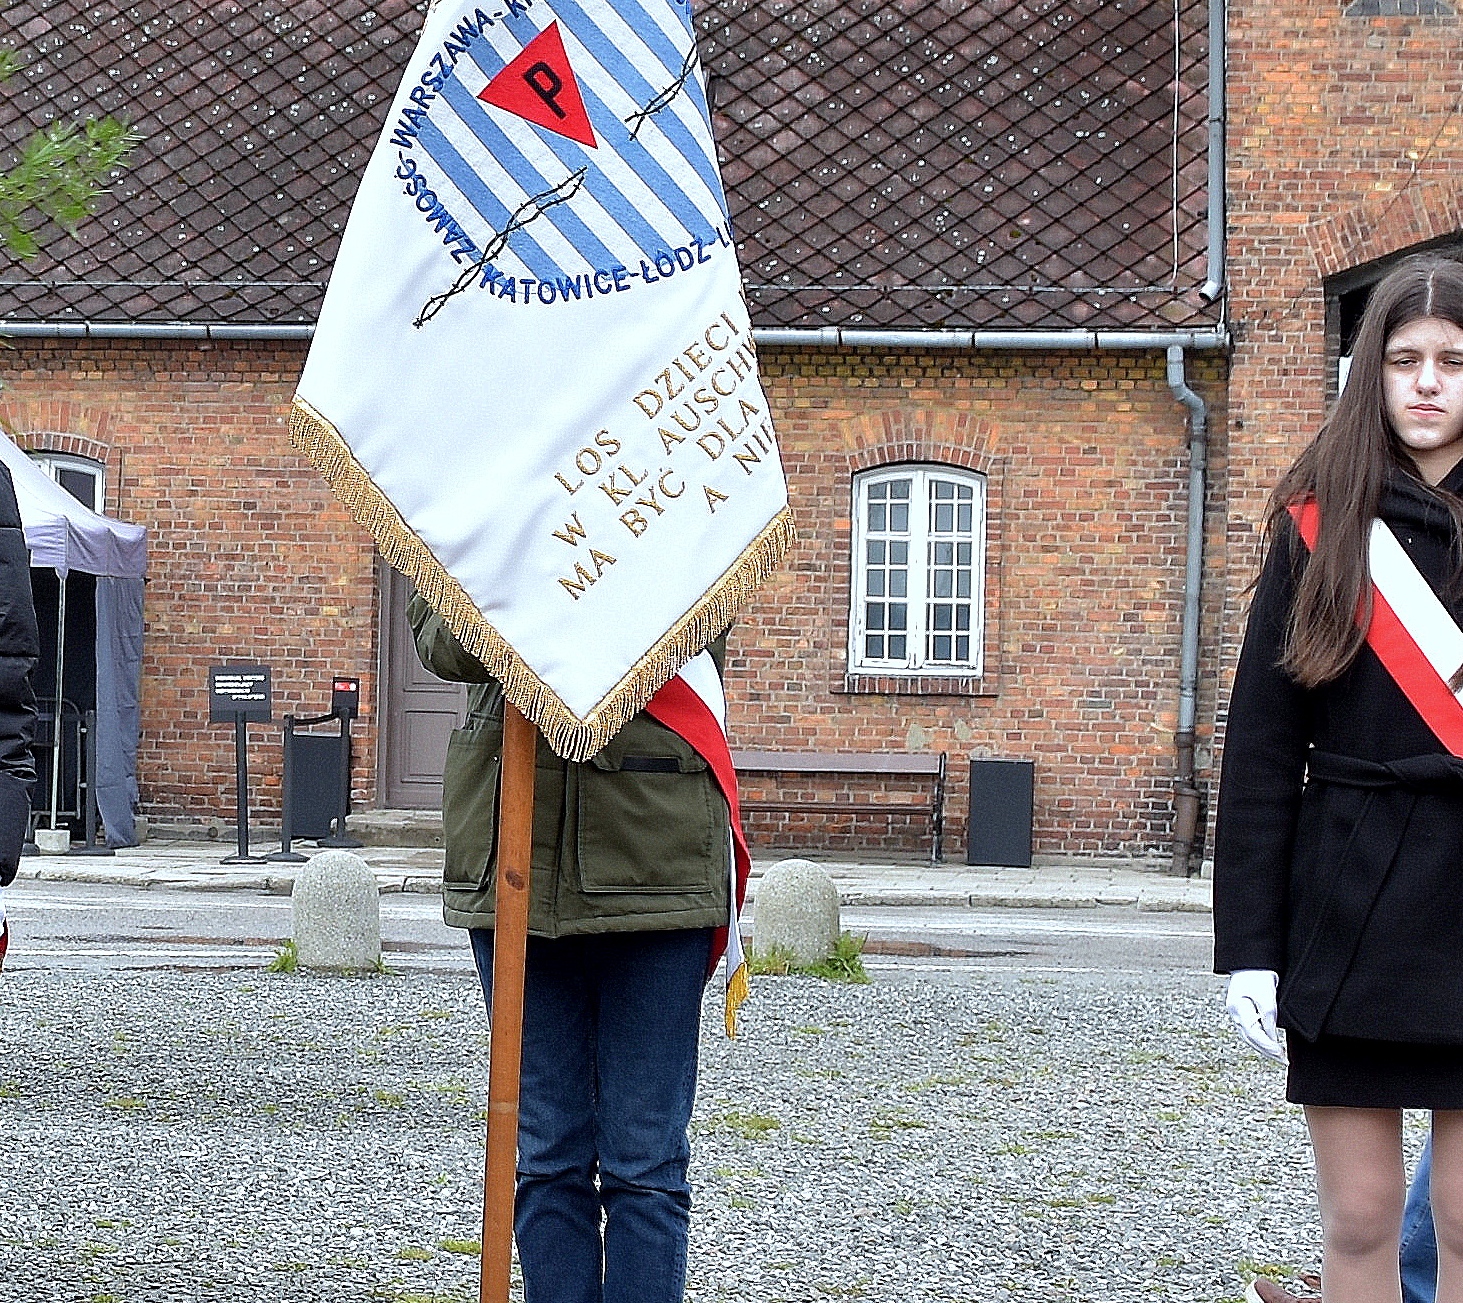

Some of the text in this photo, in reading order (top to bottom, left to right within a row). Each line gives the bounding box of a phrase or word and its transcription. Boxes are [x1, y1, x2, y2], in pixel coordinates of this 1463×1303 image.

[522, 61, 566, 119] P
[555, 311, 739, 495] LOS DZIECI
[552, 511, 587, 546] W
[598, 465, 649, 506] KL
[558, 400, 759, 599] MA BYĆ DLA
[703, 485, 729, 513] A
